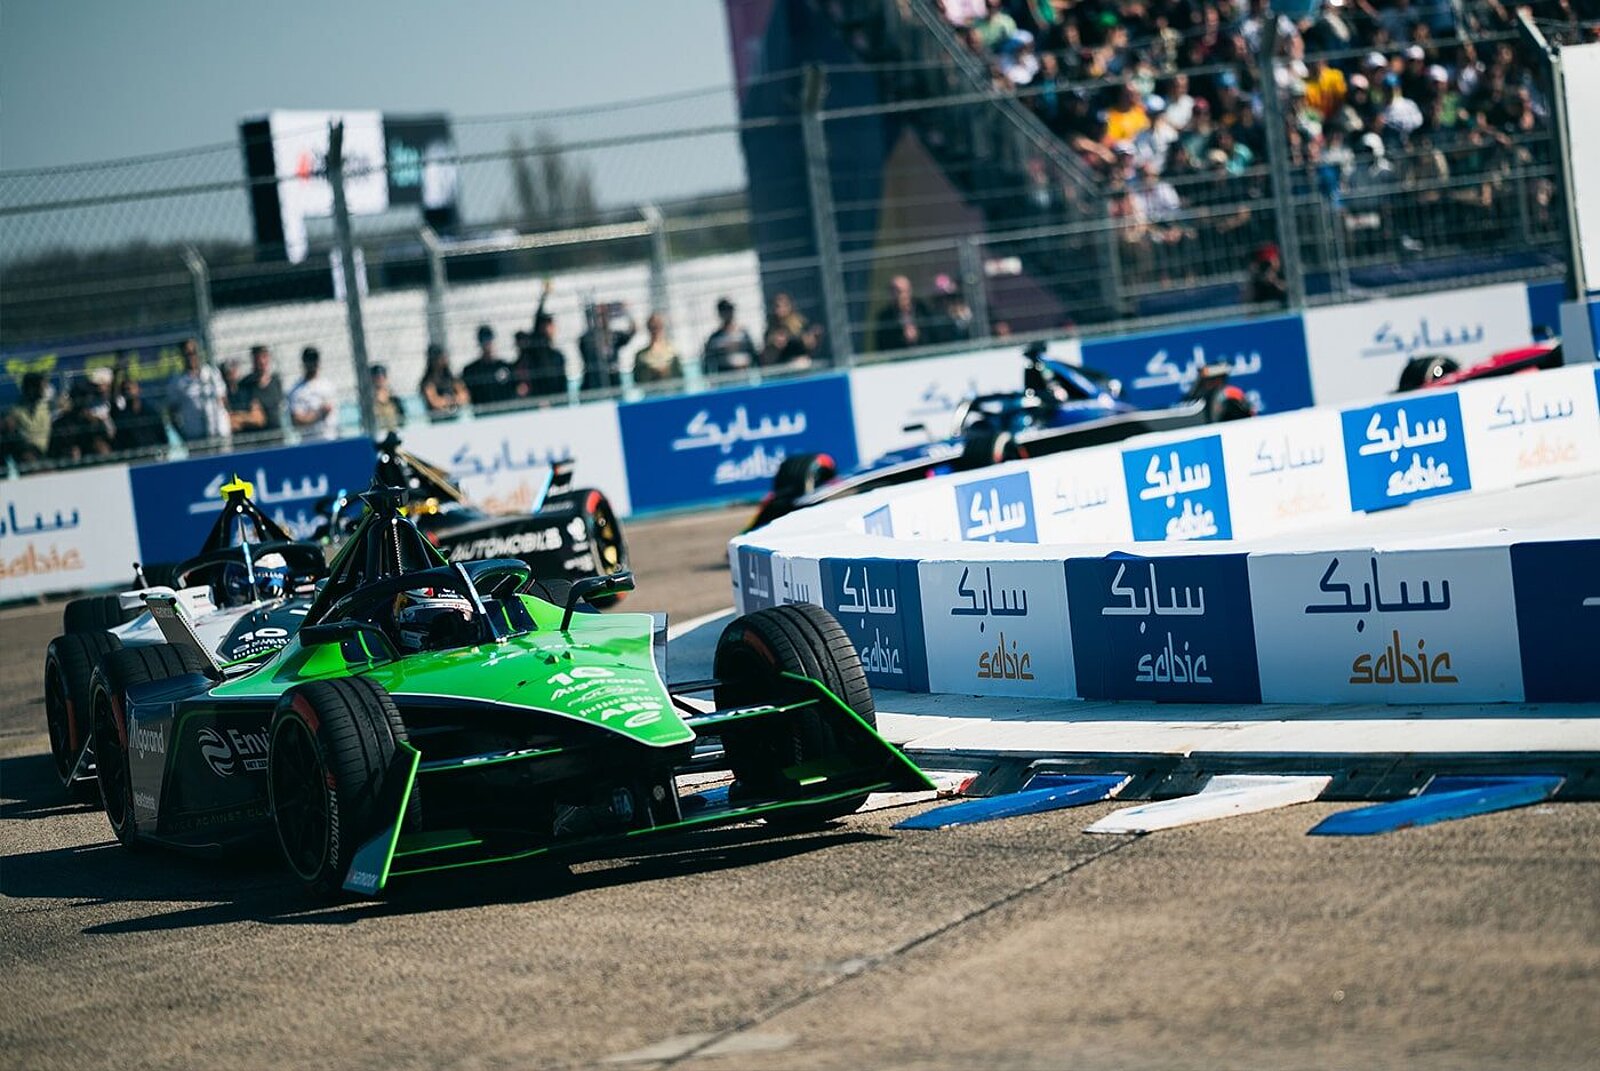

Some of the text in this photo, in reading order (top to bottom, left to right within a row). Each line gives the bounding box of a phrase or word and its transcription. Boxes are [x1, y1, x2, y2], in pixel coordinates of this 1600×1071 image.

[672, 406, 807, 453] سابك
[1358, 407, 1447, 463] سابك
[1487, 388, 1574, 436] سابك
[1139, 450, 1212, 508] سابك
[1386, 452, 1453, 497] sabic
[965, 487, 1027, 543] سابك
[837, 565, 897, 629] سابك
[950, 565, 1028, 633] سابك
[1101, 563, 1205, 635] سابك
[1304, 557, 1451, 633] سابك
[977, 632, 1036, 681] sabic
[1134, 631, 1214, 684] sabic
[1347, 629, 1460, 684] sabic
